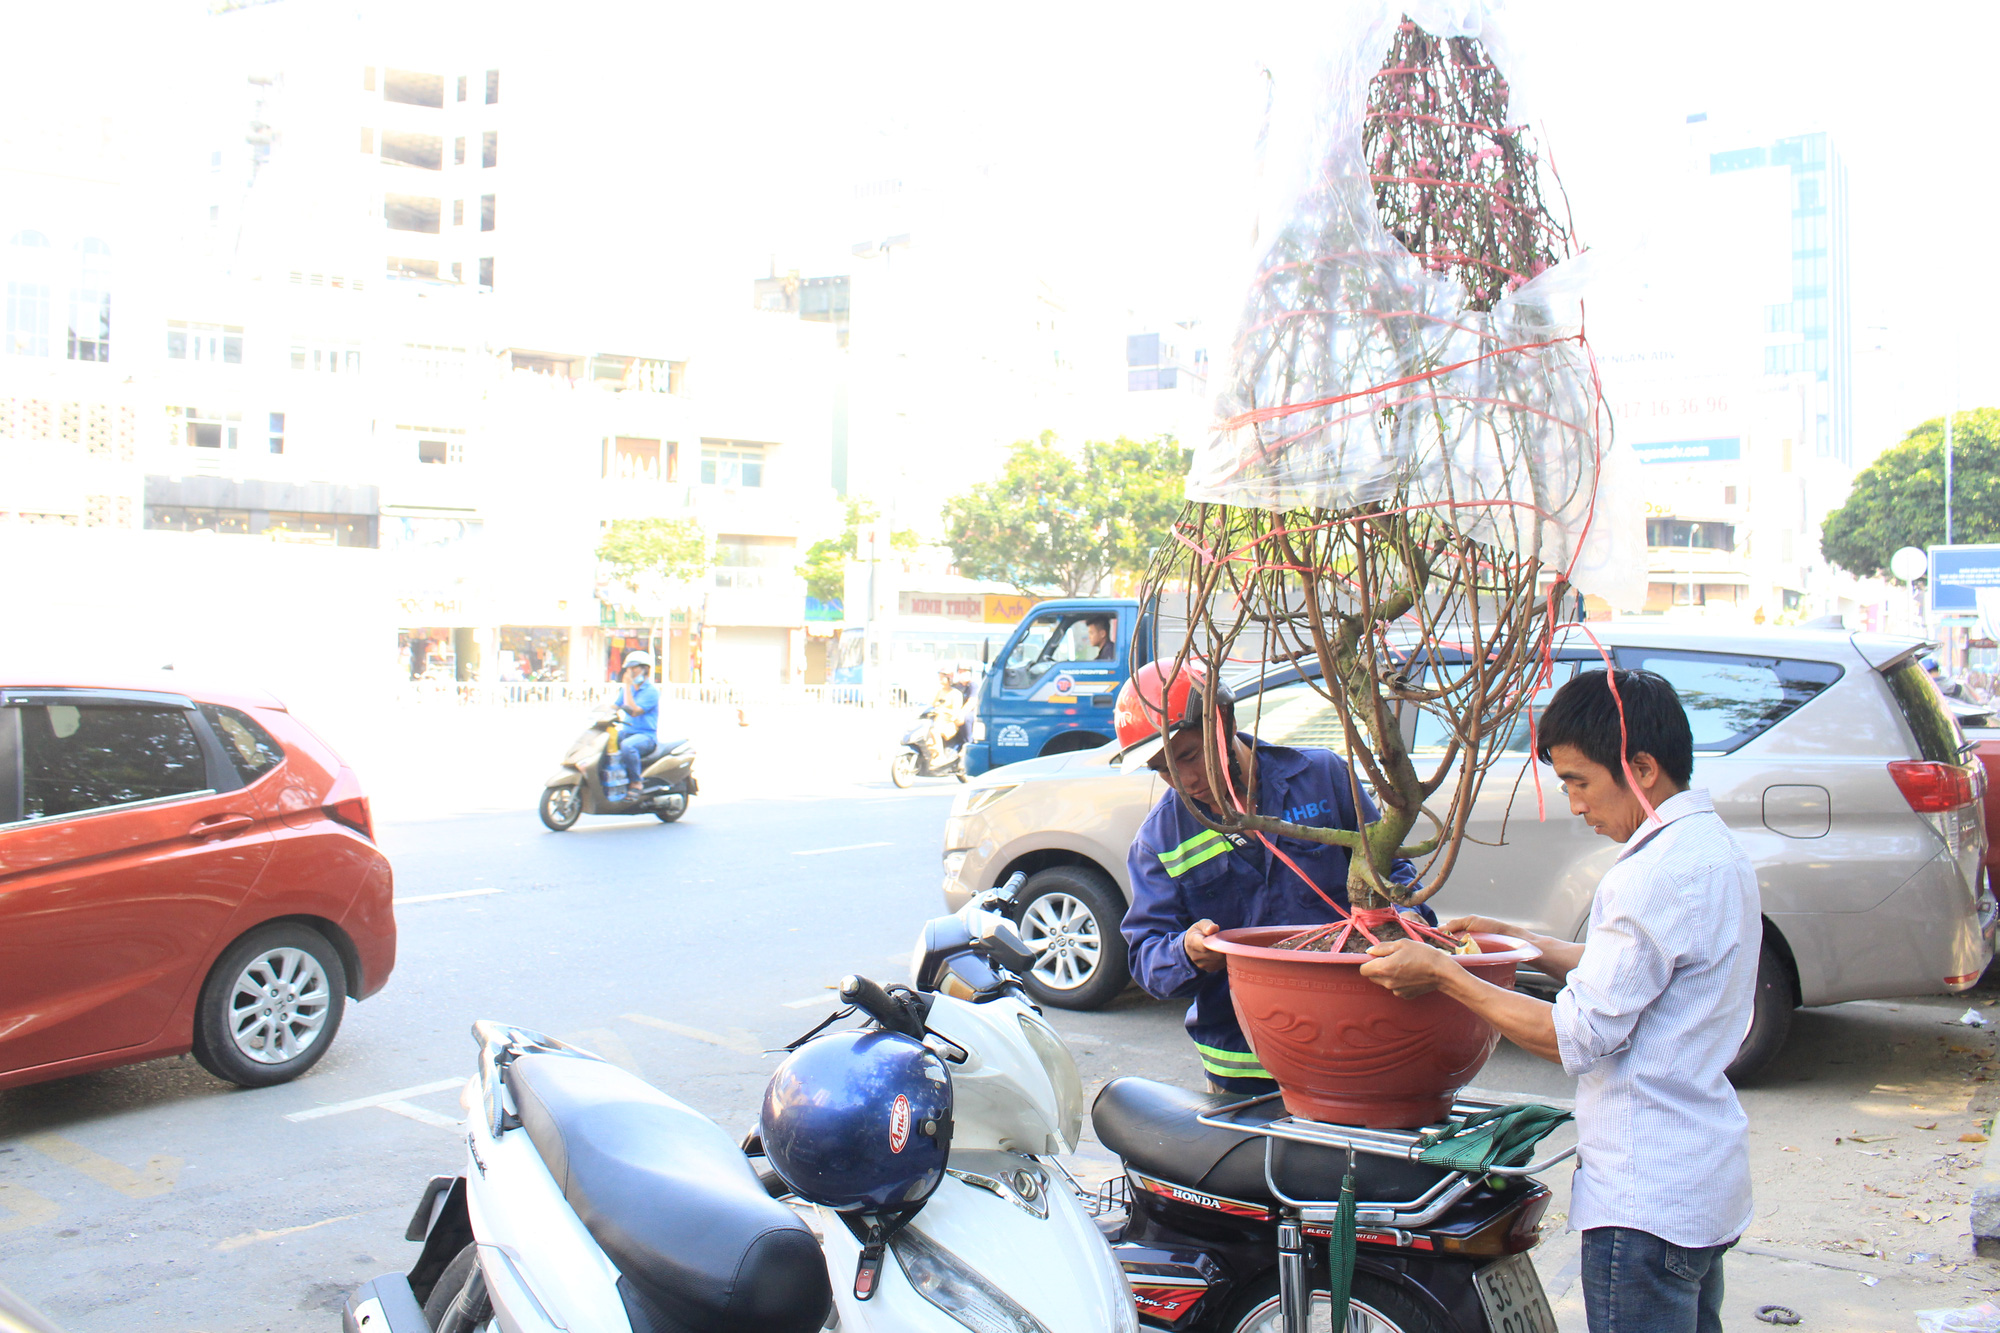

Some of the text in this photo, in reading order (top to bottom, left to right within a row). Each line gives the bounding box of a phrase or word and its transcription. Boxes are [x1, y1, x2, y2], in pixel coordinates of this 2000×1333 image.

[1651, 399, 1671, 416] 16
[1678, 397, 1700, 415] 36
[1706, 395, 1728, 413] 96
[911, 598, 943, 614] MINH
[1172, 1188, 1221, 1209] HONDA
